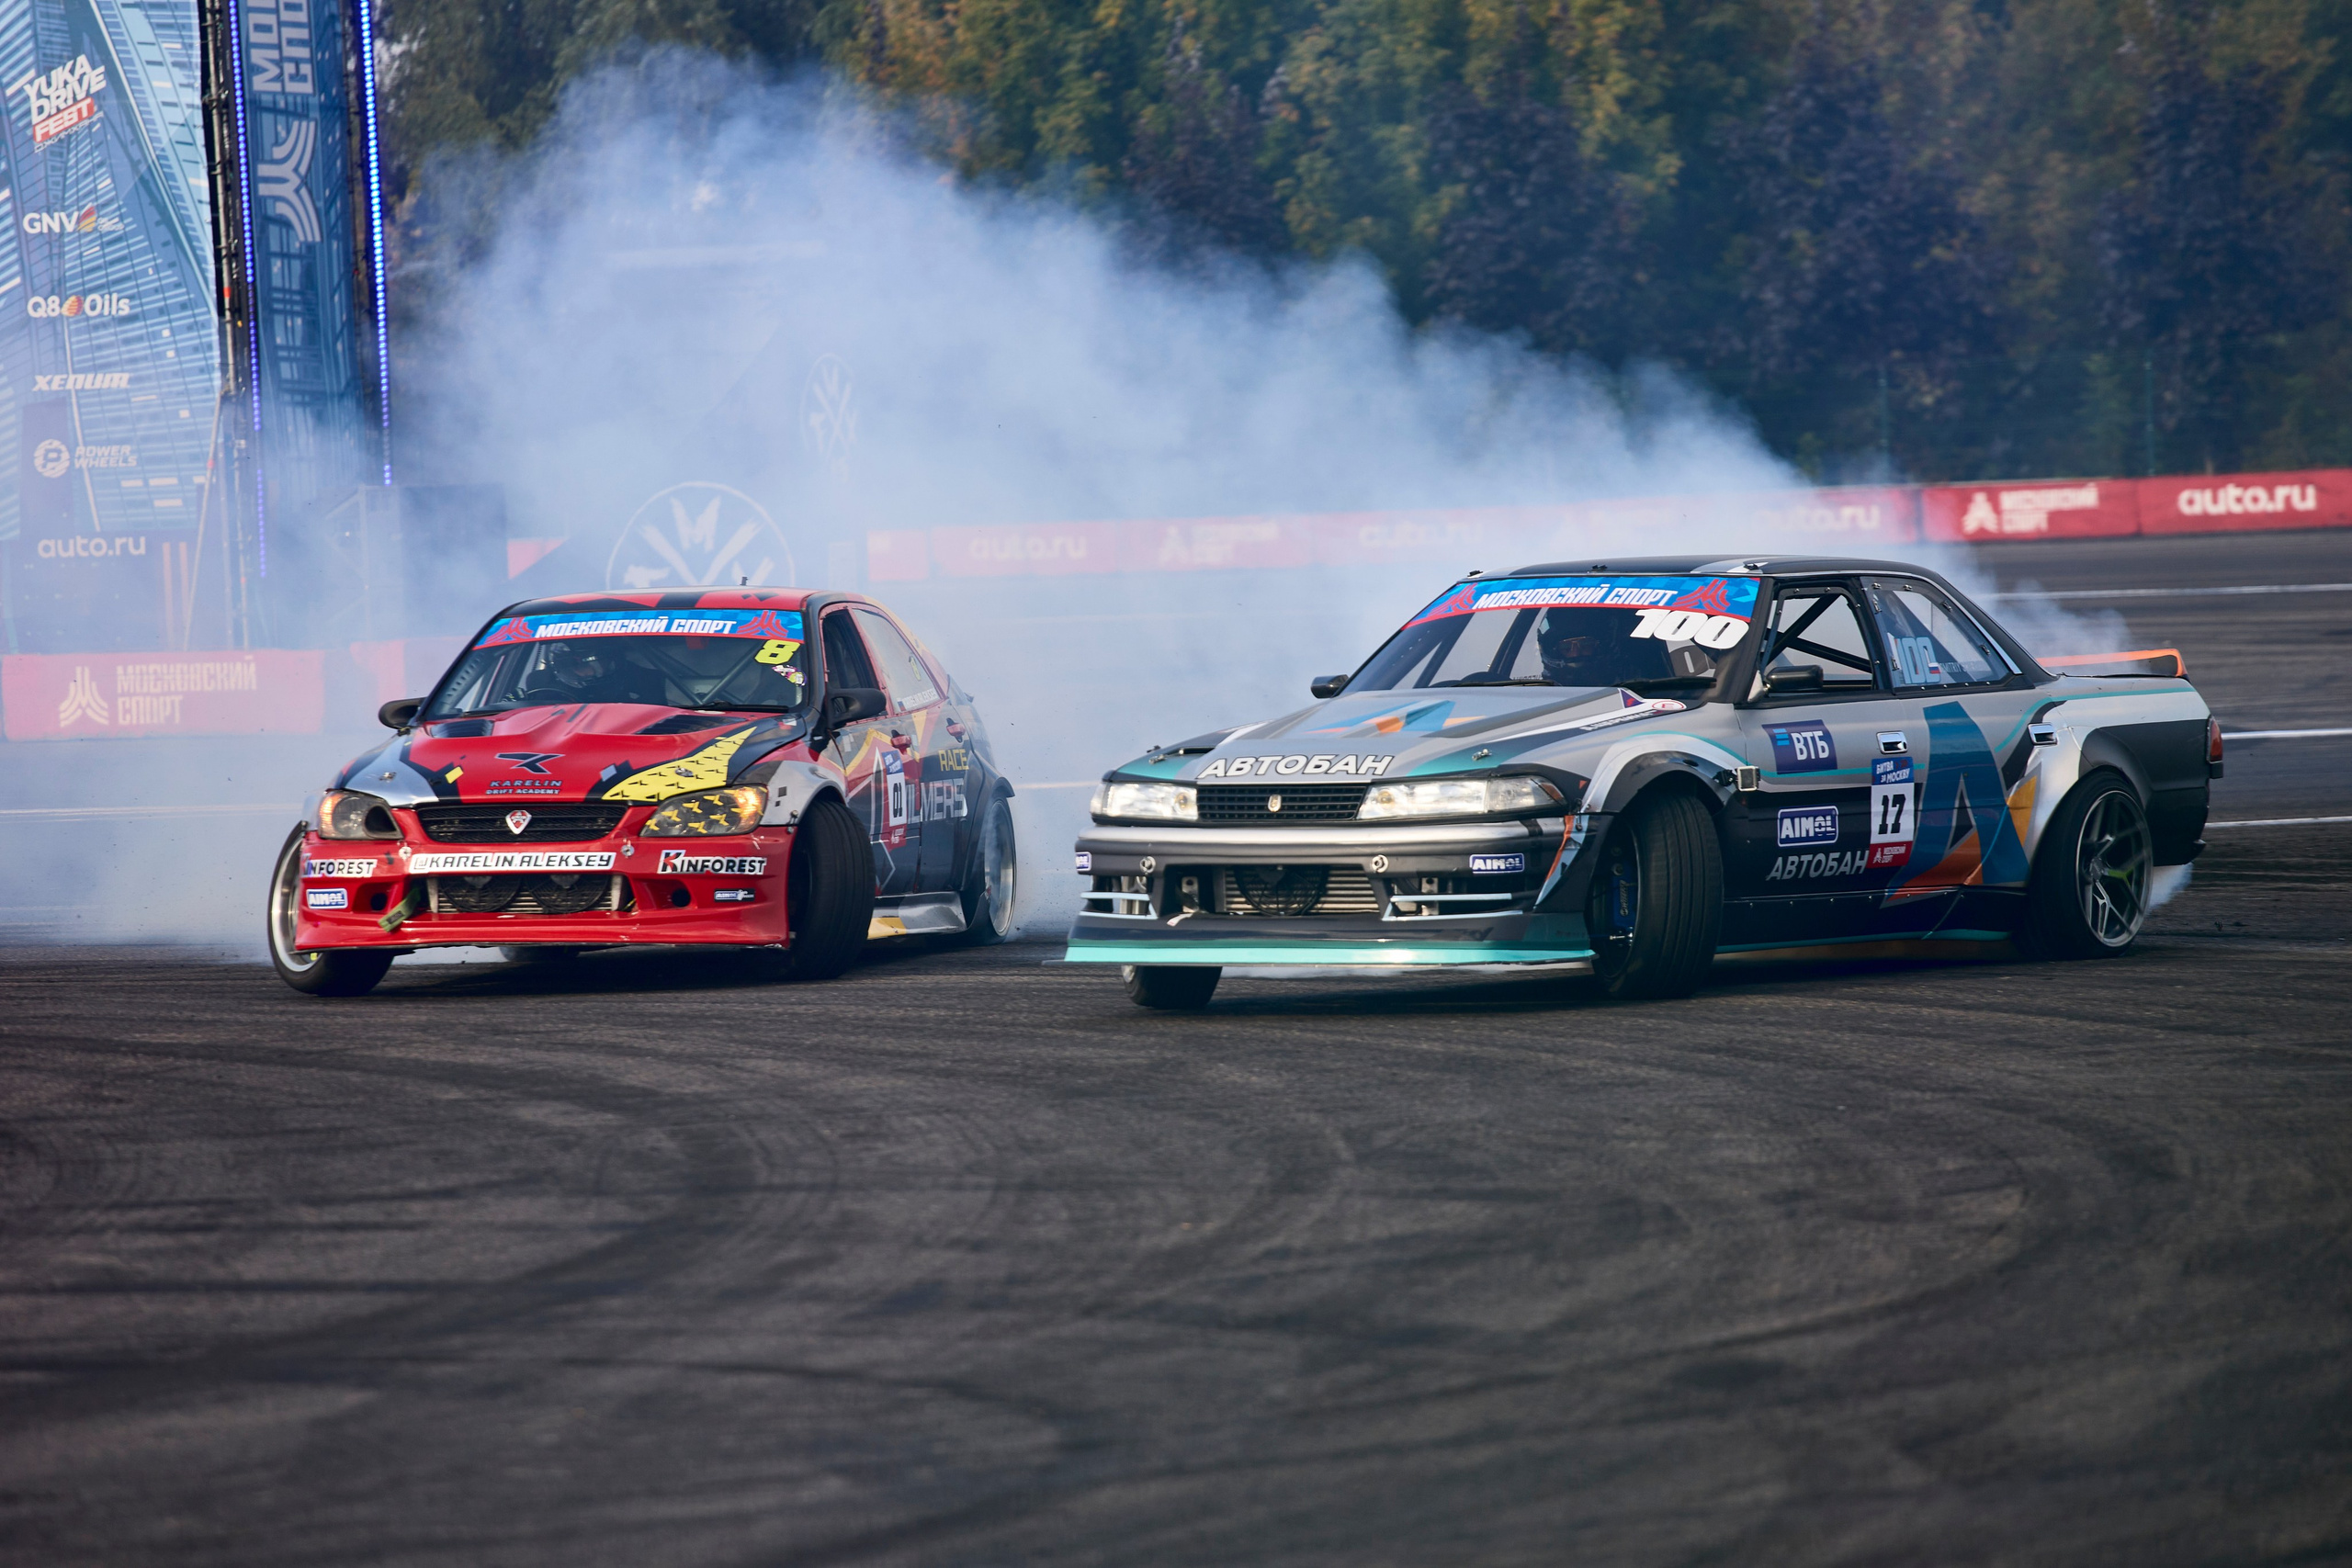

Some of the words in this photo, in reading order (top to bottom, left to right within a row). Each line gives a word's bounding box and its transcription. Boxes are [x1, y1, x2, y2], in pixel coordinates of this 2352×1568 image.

[247, 0, 283, 92] МО
[23, 54, 93, 103] YUKA
[31, 65, 107, 125] DRIVE
[35, 97, 93, 142] FEST
[23, 211, 79, 233] GNV
[27, 295, 61, 318] Q8
[85, 292, 130, 317] Oils
[74, 455, 138, 469] WHEELS
[2178, 483, 2316, 516] auto.ru
[38, 536, 146, 558] auto.ru
[1475, 584, 1613, 609] МОСКОВСКИЙ
[1608, 588, 1679, 606] СПОРТ
[534, 616, 669, 637] МОСКОВСКИЙ
[670, 619, 737, 634] СПОРТ
[1630, 609, 1749, 649] 100
[754, 639, 800, 664] 8
[116, 655, 257, 694] МОСКОВСКИЙ
[117, 694, 184, 726] СПОРТ
[1791, 731, 1829, 761] ВТБ
[938, 749, 969, 771] RACE
[1196, 754, 1395, 779] АВТОБАН
[1878, 794, 1906, 835] 17
[1781, 816, 1836, 839] AIMOL
[414, 853, 613, 871] @KARELIN.ALEKSEY
[661, 852, 766, 874] KINFOREST
[1472, 858, 1522, 870] AIMOL
[1768, 851, 1869, 880] АВТОБАН
